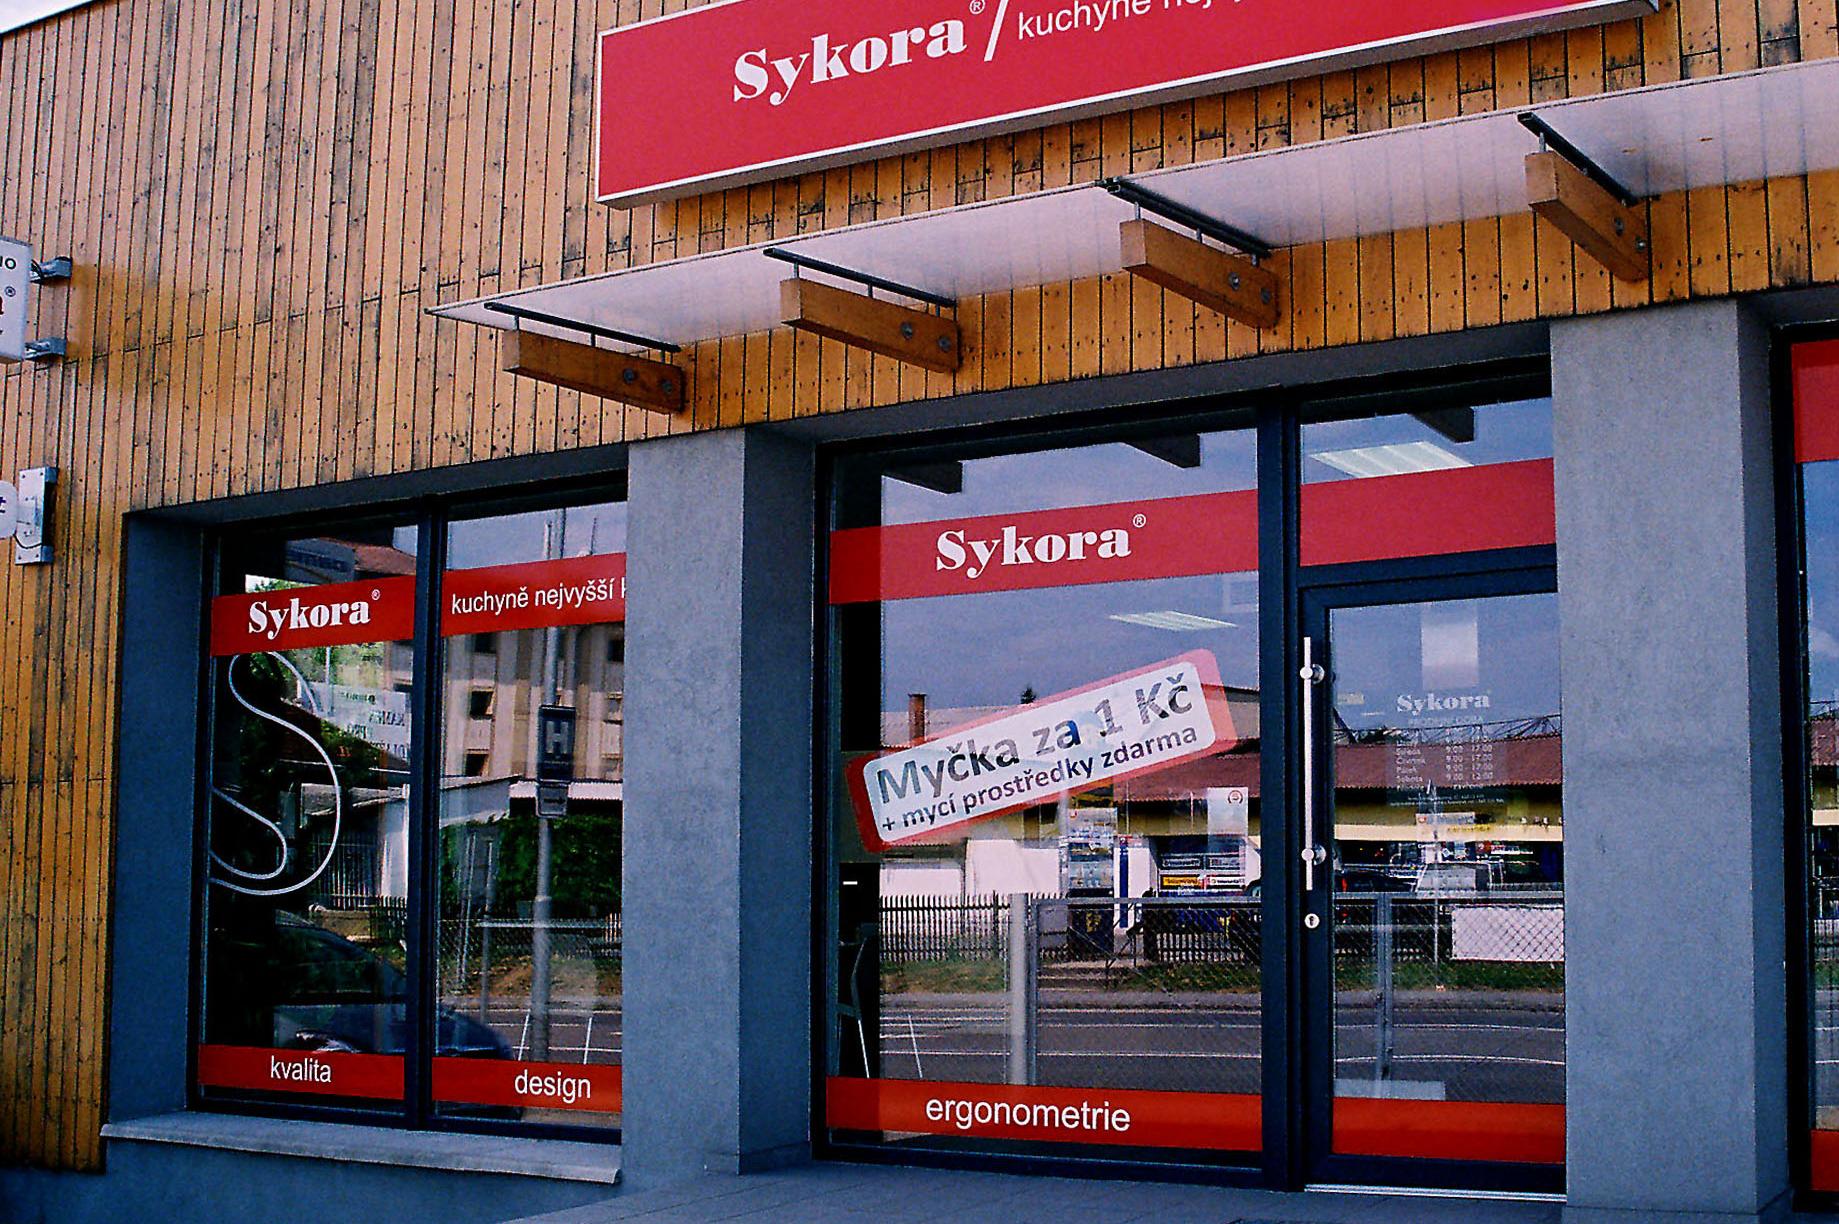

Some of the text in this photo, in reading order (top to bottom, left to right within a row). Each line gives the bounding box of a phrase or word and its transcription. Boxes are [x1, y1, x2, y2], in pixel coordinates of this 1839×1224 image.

[733, 19, 967, 106] Sykora
[936, 526, 1132, 579] Sykora
[452, 586, 529, 616] kuchyně
[535, 578, 615, 610] nejvyšší
[246, 597, 371, 640] Sykora
[1396, 692, 1491, 717] Sykora
[876, 672, 1193, 804] Myčka za 1 Kč
[902, 792, 957, 828] mycí
[962, 756, 1095, 815] prostředky
[1100, 726, 1198, 769] zdarma
[270, 1055, 332, 1083] kvalita
[514, 1069, 592, 1104] design
[926, 1099, 1131, 1132] ergonometrie
